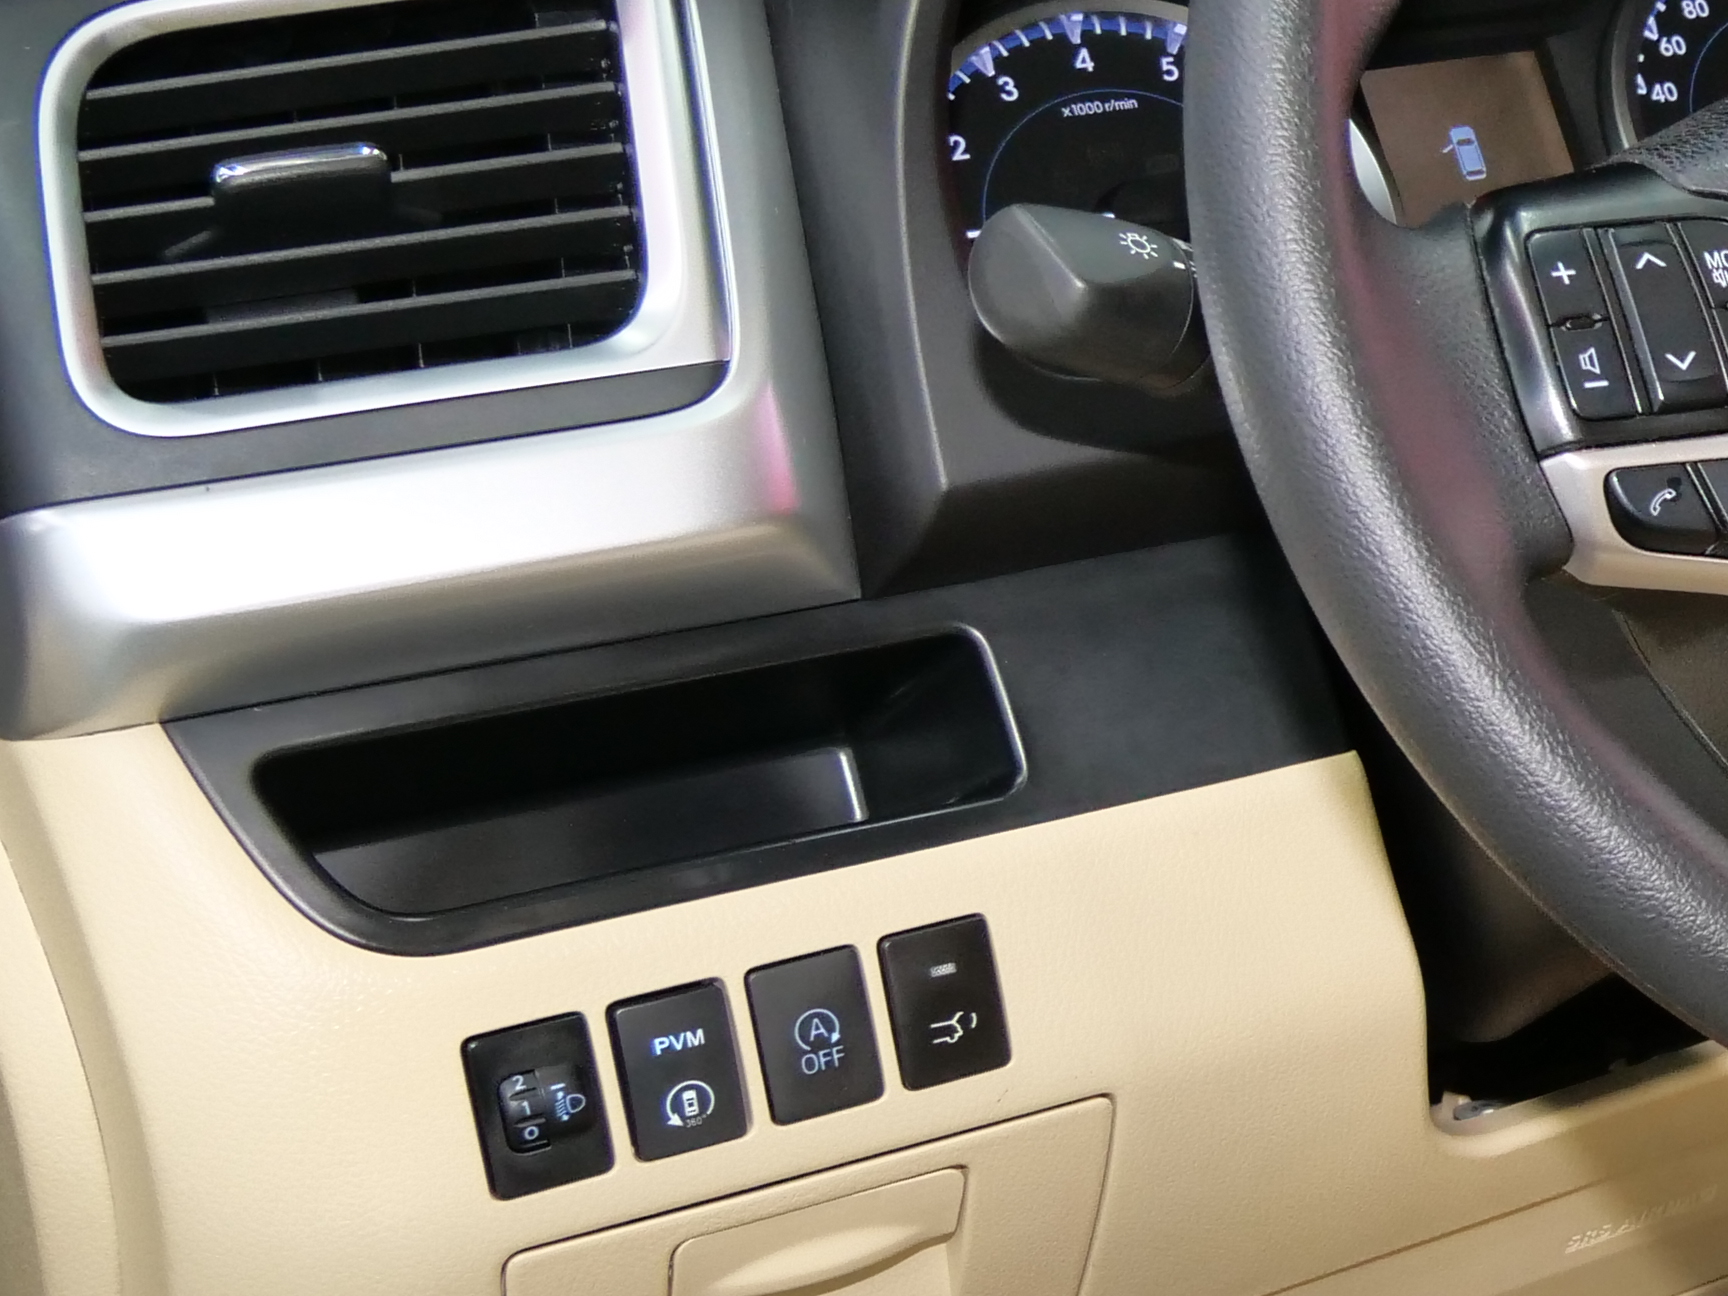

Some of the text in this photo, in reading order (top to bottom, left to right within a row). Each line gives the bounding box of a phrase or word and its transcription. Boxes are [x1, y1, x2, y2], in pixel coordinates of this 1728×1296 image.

[1658, 34, 1687, 57] 60
[1074, 47, 1095, 73] 4
[1160, 56, 1180, 82] 5
[997, 76, 1019, 102] 3
[1651, 81, 1679, 104] 40
[1104, 97, 1139, 113] r/min
[949, 135, 971, 161] 2
[809, 1018, 828, 1041] A
[653, 1028, 705, 1056] PVM
[801, 1045, 846, 1075] OFF
[511, 1074, 527, 1091] 2
[521, 1100, 532, 1116] 1
